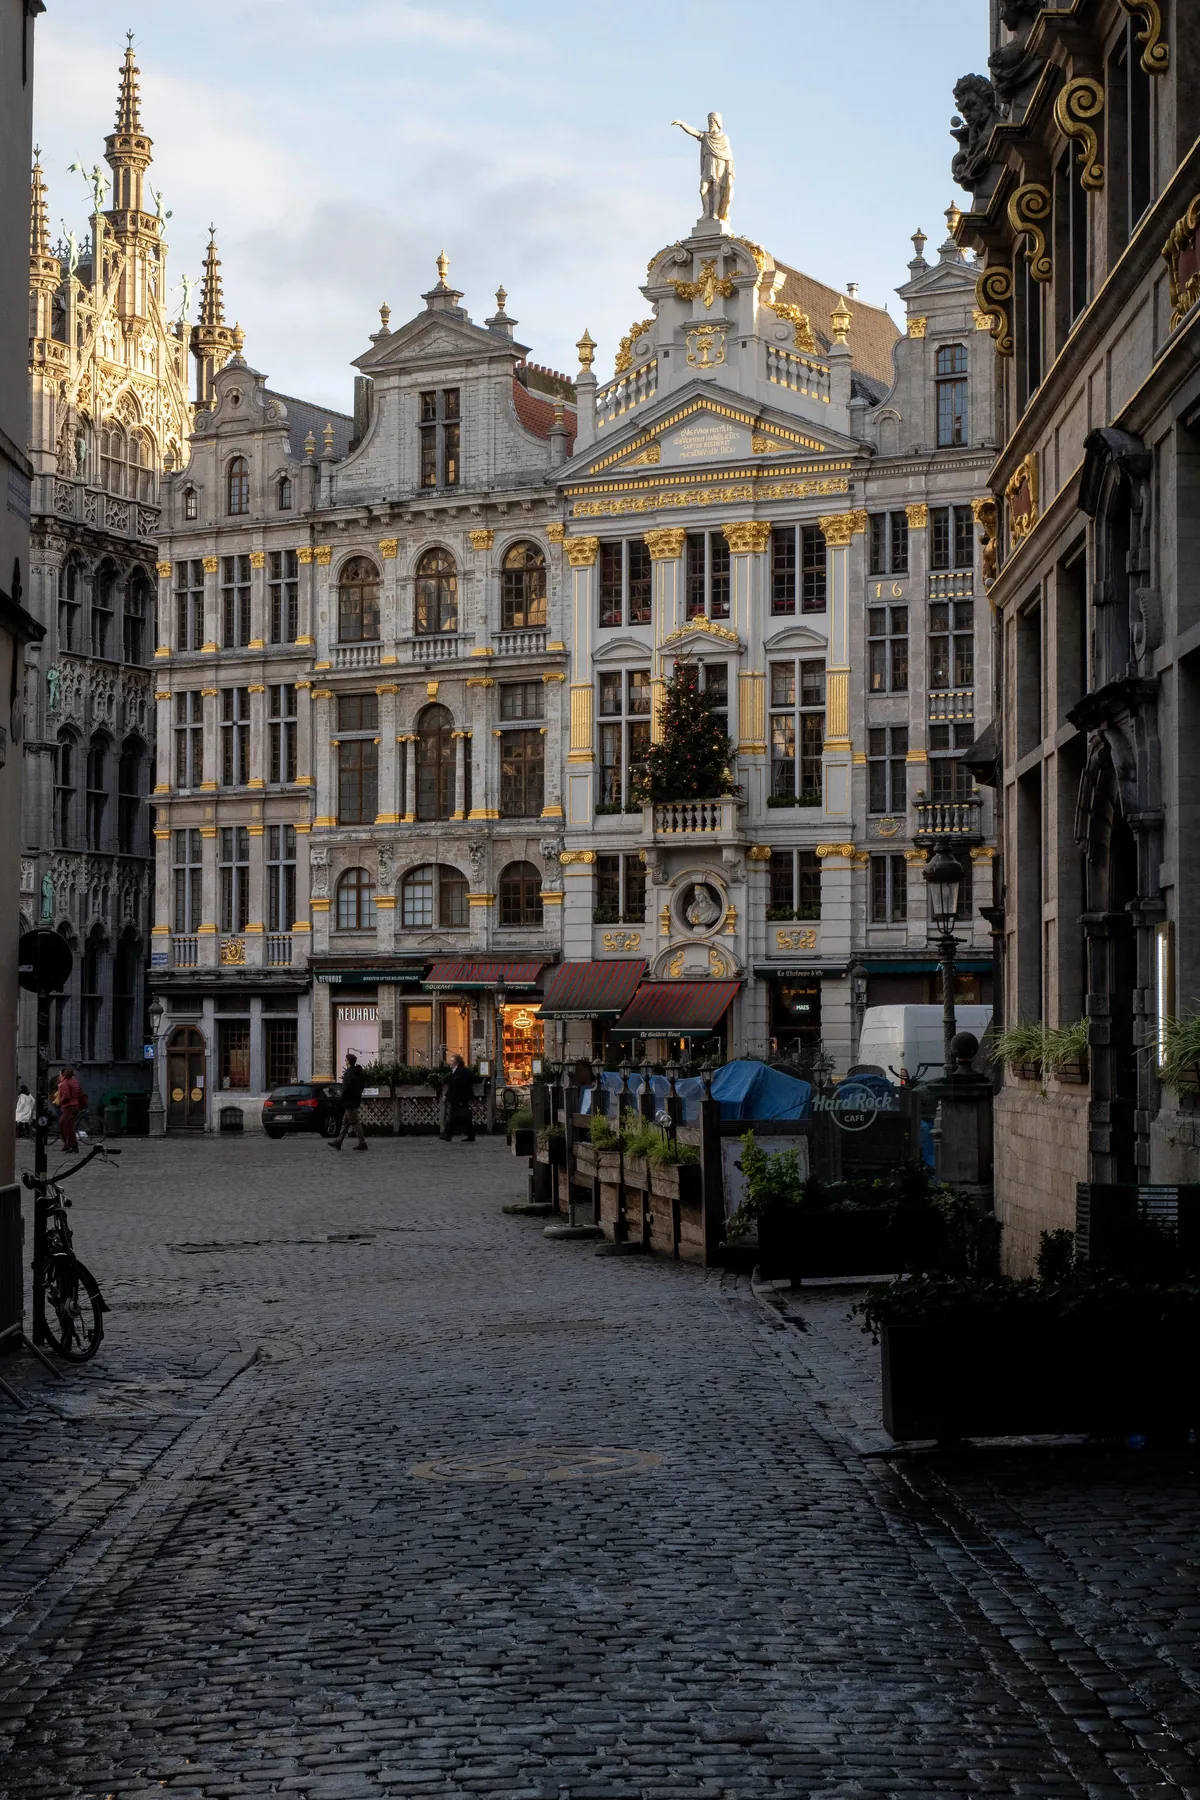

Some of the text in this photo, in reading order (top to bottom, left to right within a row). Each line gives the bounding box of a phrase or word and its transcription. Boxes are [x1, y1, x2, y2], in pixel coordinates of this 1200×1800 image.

[318, 975, 342, 983] NEUHAUS
[812, 1091, 893, 1112] Hard Rock
[844, 1114, 865, 1122] CAFE
